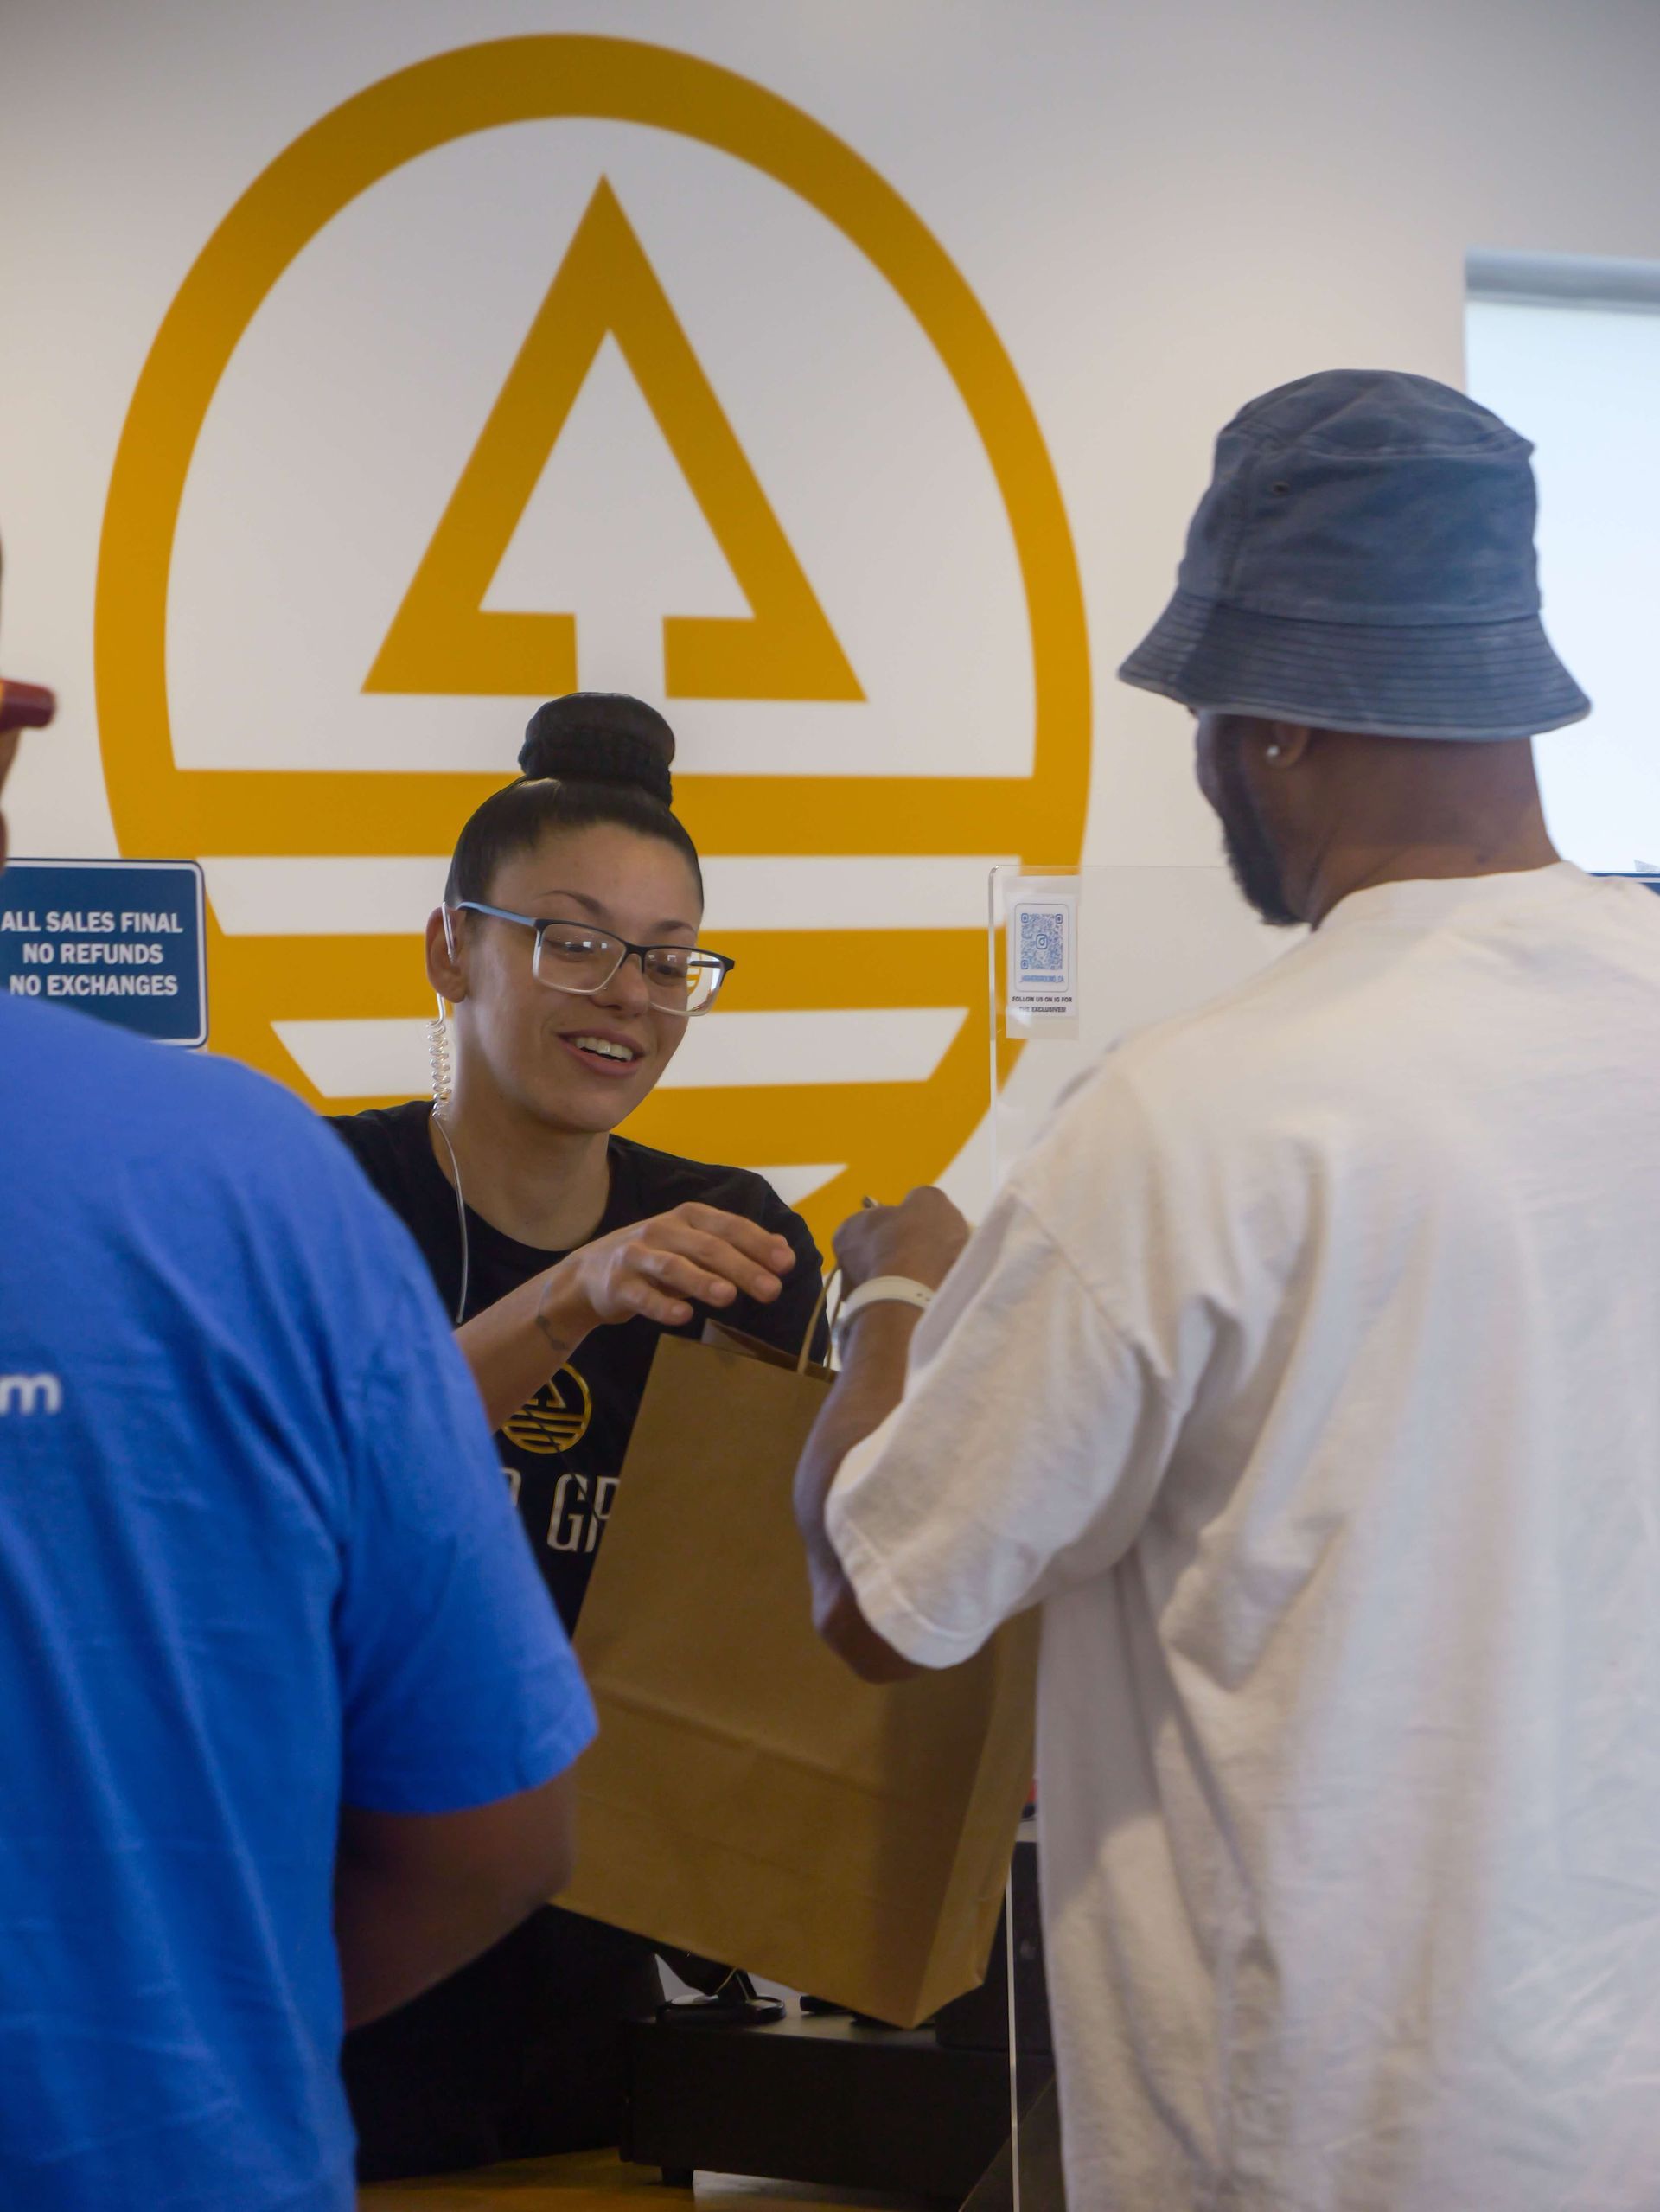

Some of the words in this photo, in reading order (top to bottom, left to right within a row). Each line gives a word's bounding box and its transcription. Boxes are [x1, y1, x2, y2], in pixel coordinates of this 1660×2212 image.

[1, 911, 42, 932] ALL
[46, 911, 115, 933] SALES
[121, 912, 183, 933] FINAL
[22, 943, 54, 964] NO
[60, 943, 163, 965] REFUNDS
[9, 975, 42, 996] NO
[47, 975, 178, 996] EXCHANGES
